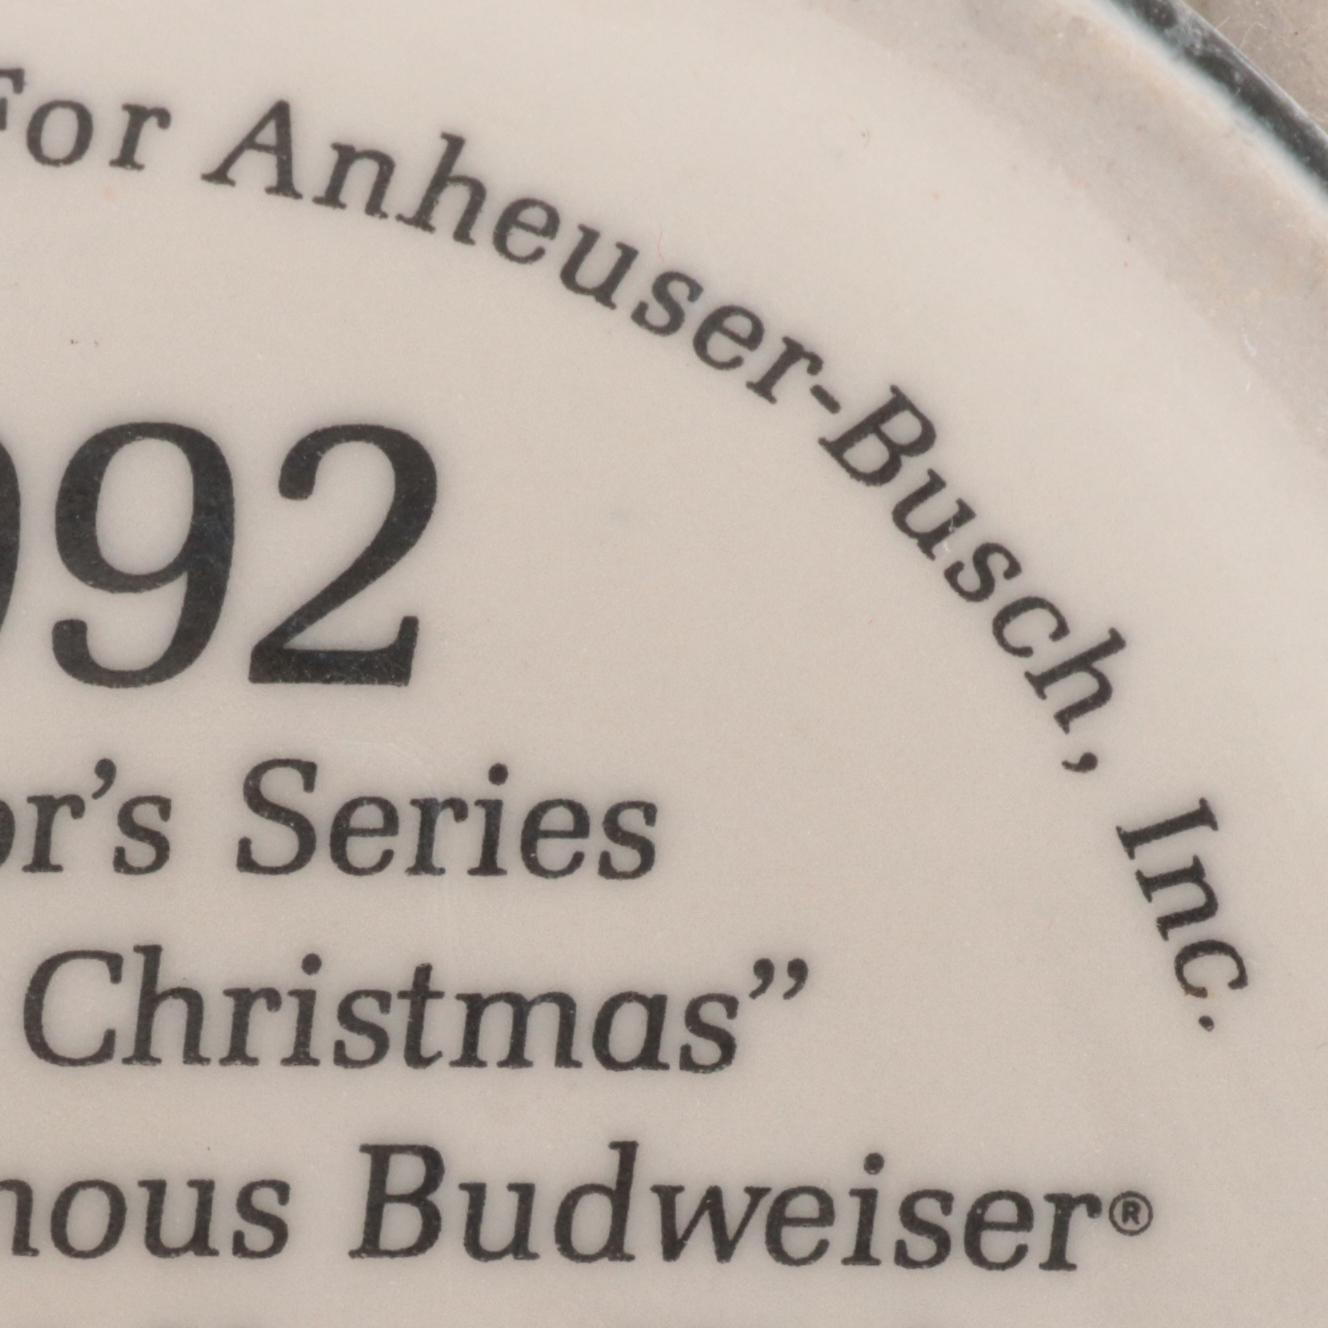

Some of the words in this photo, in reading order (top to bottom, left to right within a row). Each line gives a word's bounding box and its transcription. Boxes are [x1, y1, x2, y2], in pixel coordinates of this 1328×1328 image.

[200, 99, 1128, 775] Anheuser-Busch,
[1114, 796, 1250, 1033] Inc.
[234, 756, 659, 882] Series
